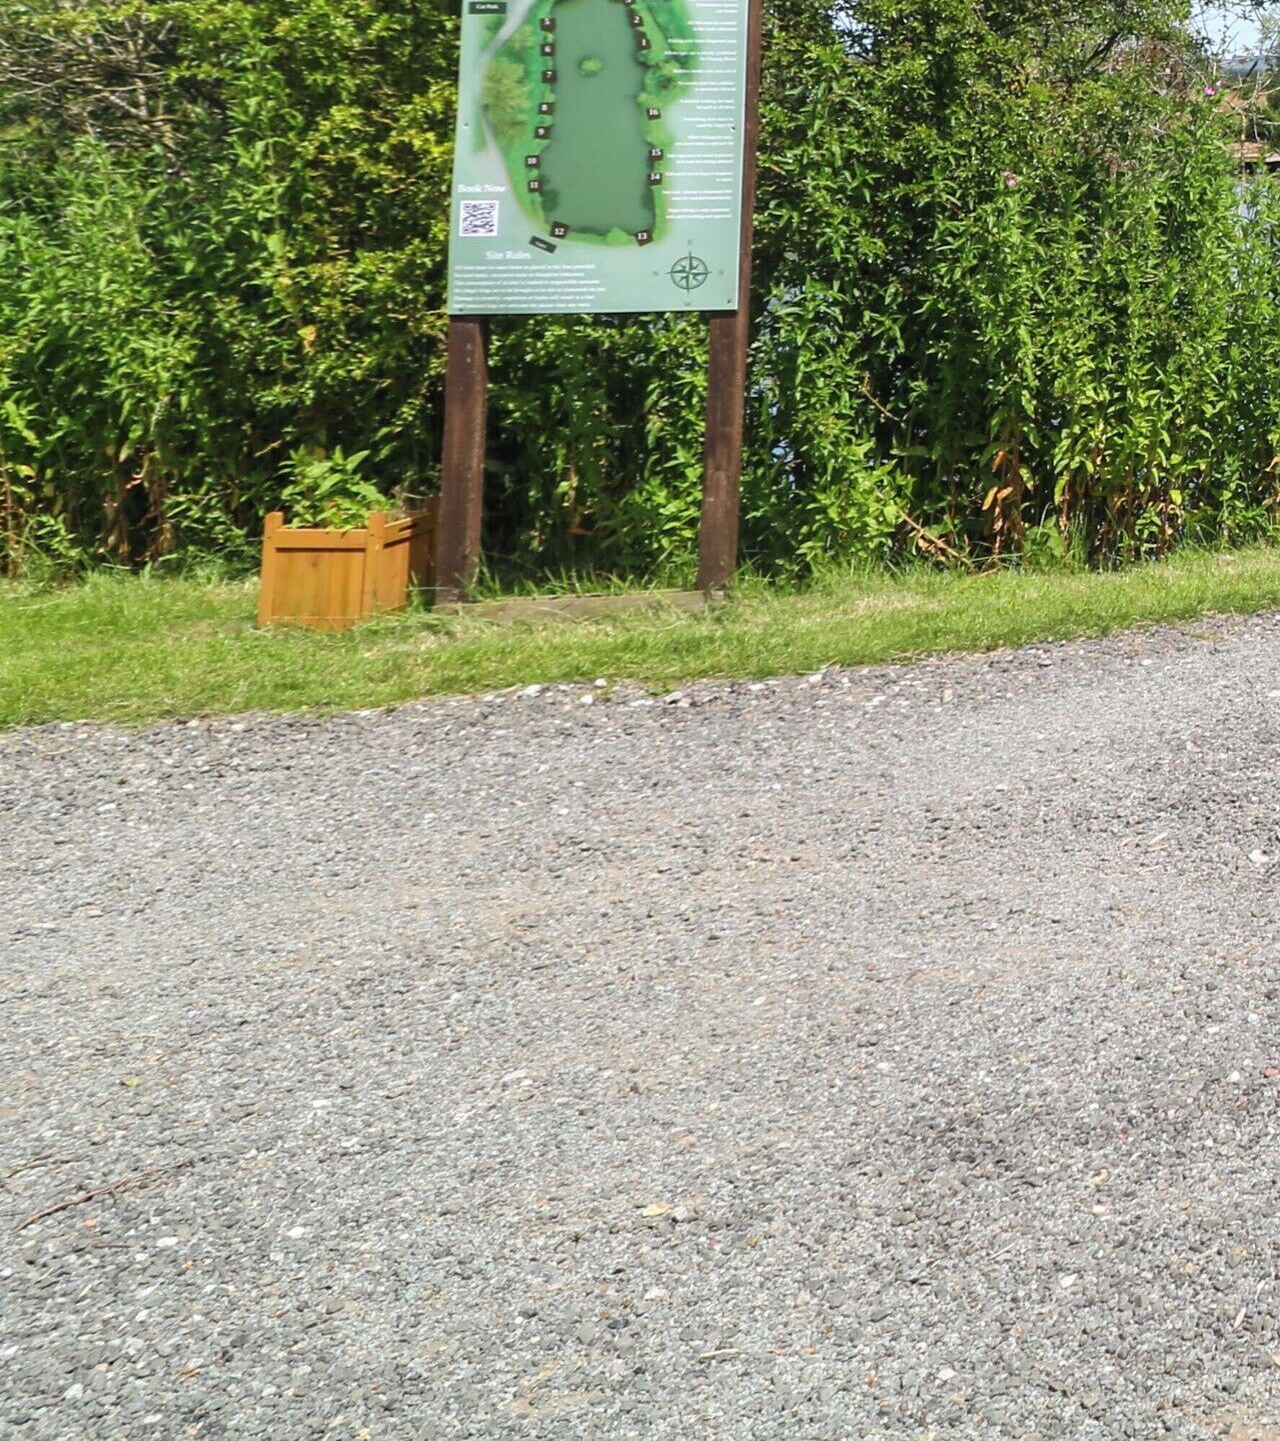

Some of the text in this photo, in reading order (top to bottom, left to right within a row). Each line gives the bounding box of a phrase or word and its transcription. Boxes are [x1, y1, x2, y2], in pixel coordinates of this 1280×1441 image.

[633, 15, 640, 23] 2
[537, 128, 545, 136] 9
[457, 184, 506, 192] Book Now
[530, 181, 539, 189] 11
[554, 227, 565, 236] 12
[637, 232, 647, 240] 13
[485, 251, 531, 260] Site Rules
